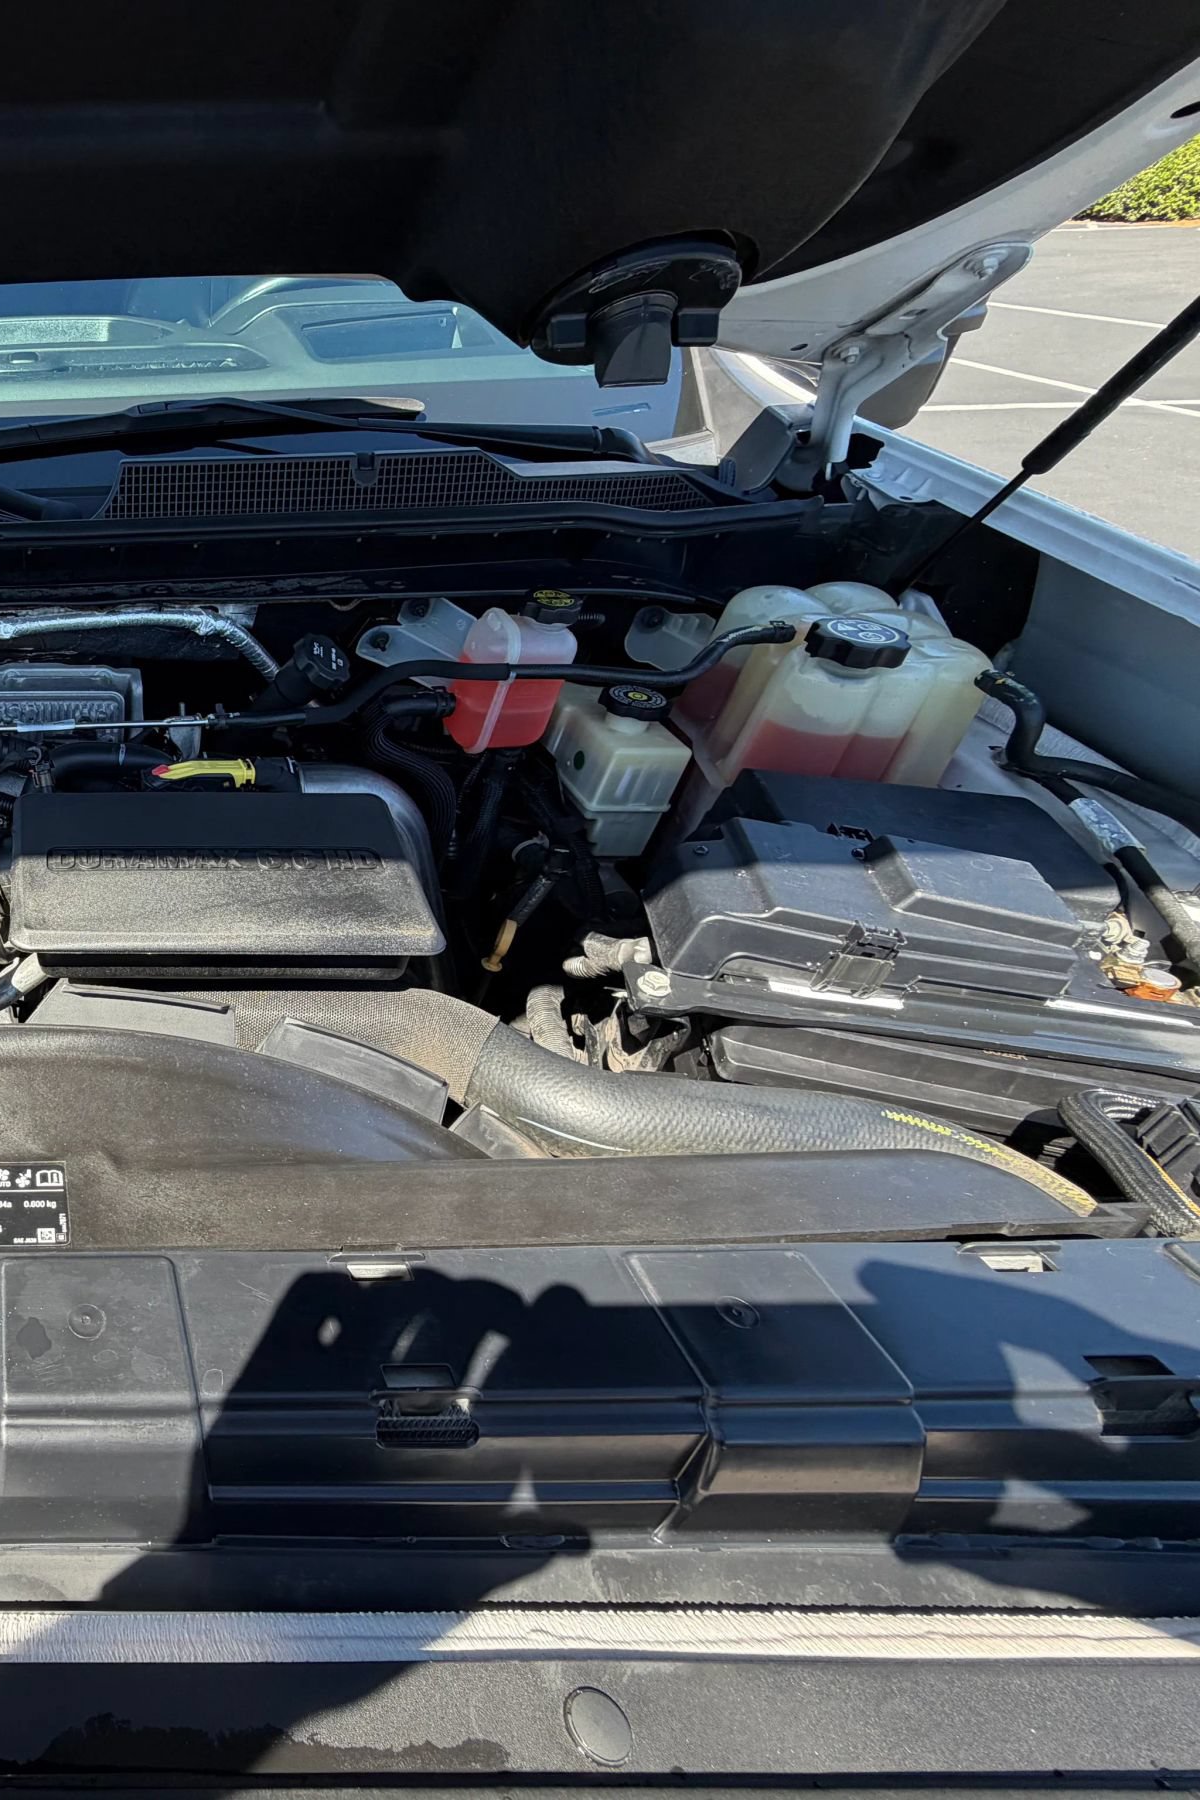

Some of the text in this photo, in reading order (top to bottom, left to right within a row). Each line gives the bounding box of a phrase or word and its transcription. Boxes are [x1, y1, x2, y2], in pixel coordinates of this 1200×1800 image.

[49, 849, 243, 870] DURAMAX
[323, 849, 385, 870] HD
[46, 1199, 57, 1210] kg
